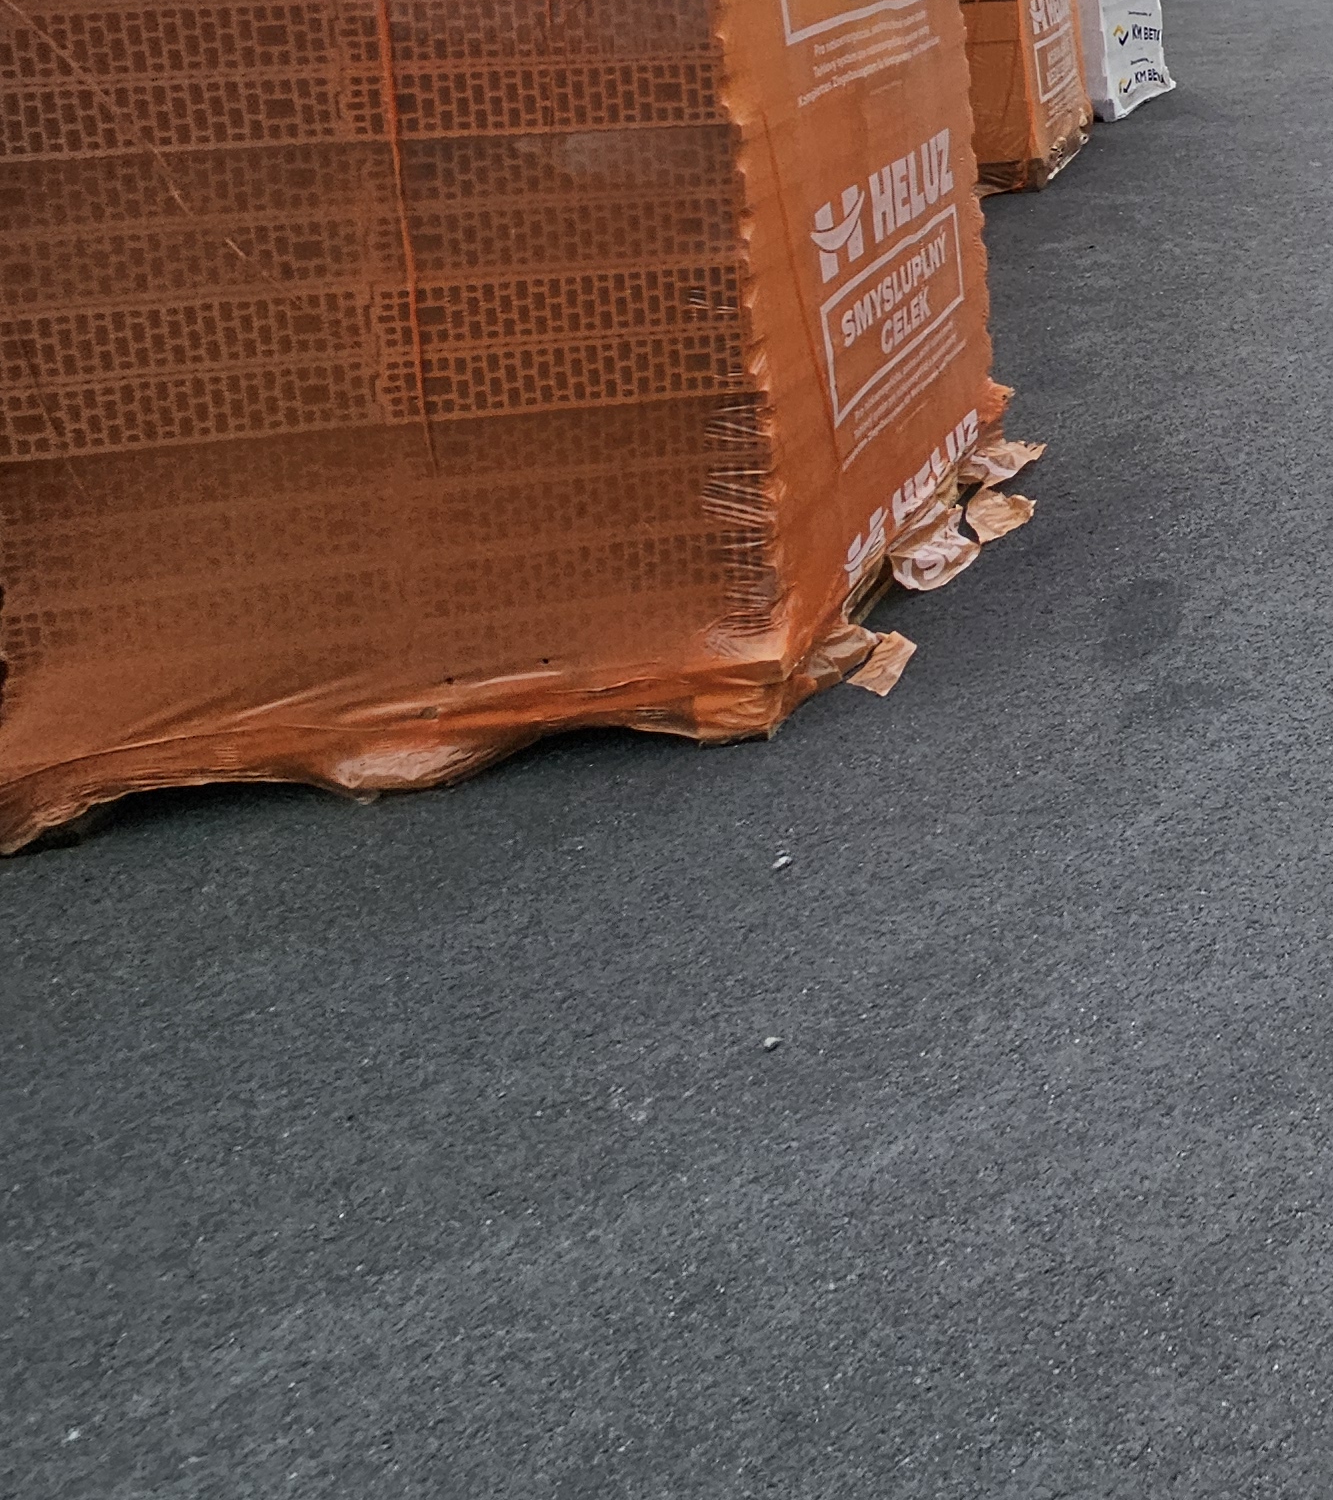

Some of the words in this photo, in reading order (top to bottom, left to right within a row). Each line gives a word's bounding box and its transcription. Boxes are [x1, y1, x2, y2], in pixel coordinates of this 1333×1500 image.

[1131, 24, 1142, 40] KM
[868, 128, 954, 244] HELUZ
[841, 227, 949, 347] SMYSLUPLNÝ
[880, 288, 932, 355] CELEK
